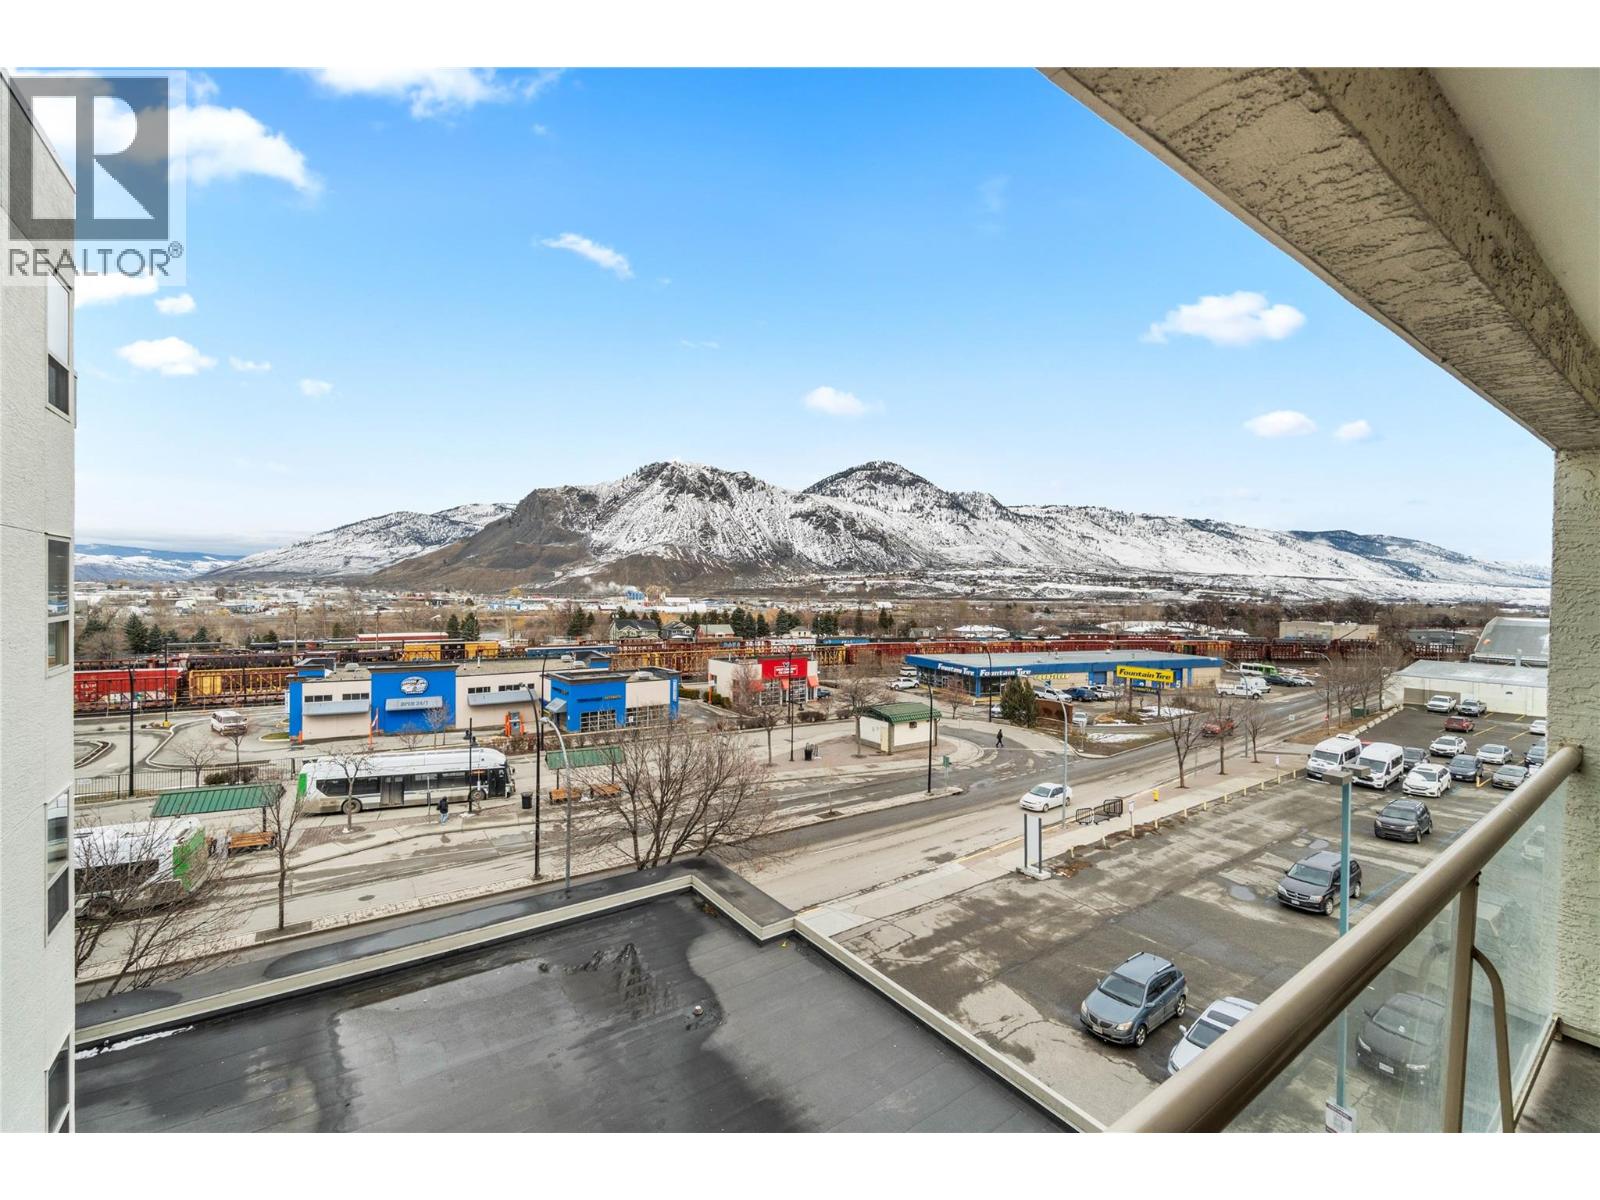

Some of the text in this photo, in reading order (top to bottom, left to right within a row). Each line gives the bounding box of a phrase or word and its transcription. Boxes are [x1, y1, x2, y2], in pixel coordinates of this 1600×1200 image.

[1016, 667, 1032, 676] Tire
[1119, 668, 1172, 680] Fountain Tire
